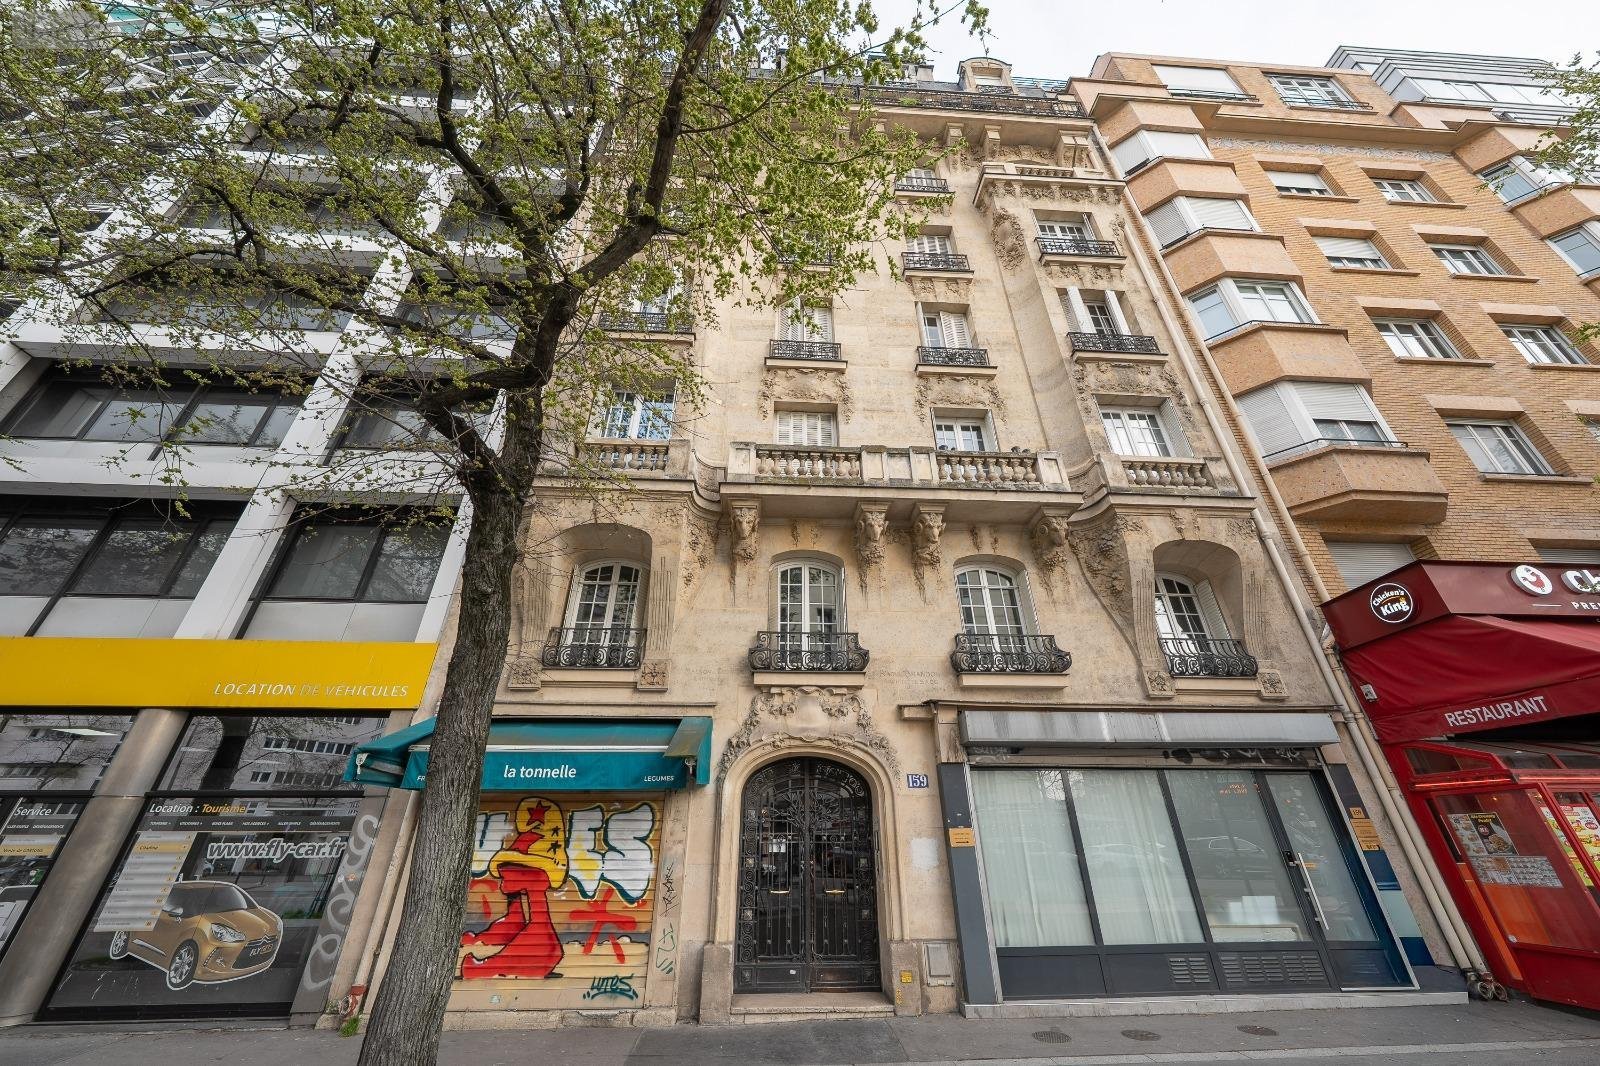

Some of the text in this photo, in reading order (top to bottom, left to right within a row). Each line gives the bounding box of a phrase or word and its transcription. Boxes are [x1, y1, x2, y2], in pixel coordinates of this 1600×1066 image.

[1372, 588, 1405, 606] Chicken's
[1380, 601, 1410, 616] King
[214, 683, 296, 696] LOCATION
[300, 684, 320, 696] DE
[1444, 696, 1548, 727] RESTAURANT
[503, 764, 577, 778] la tonnelle
[907, 774, 927, 788] 159
[14, 806, 52, 816] Service
[149, 803, 193, 814] Location
[201, 803, 246, 814] Tourisme
[207, 837, 347, 864] www.fly-car.fr
